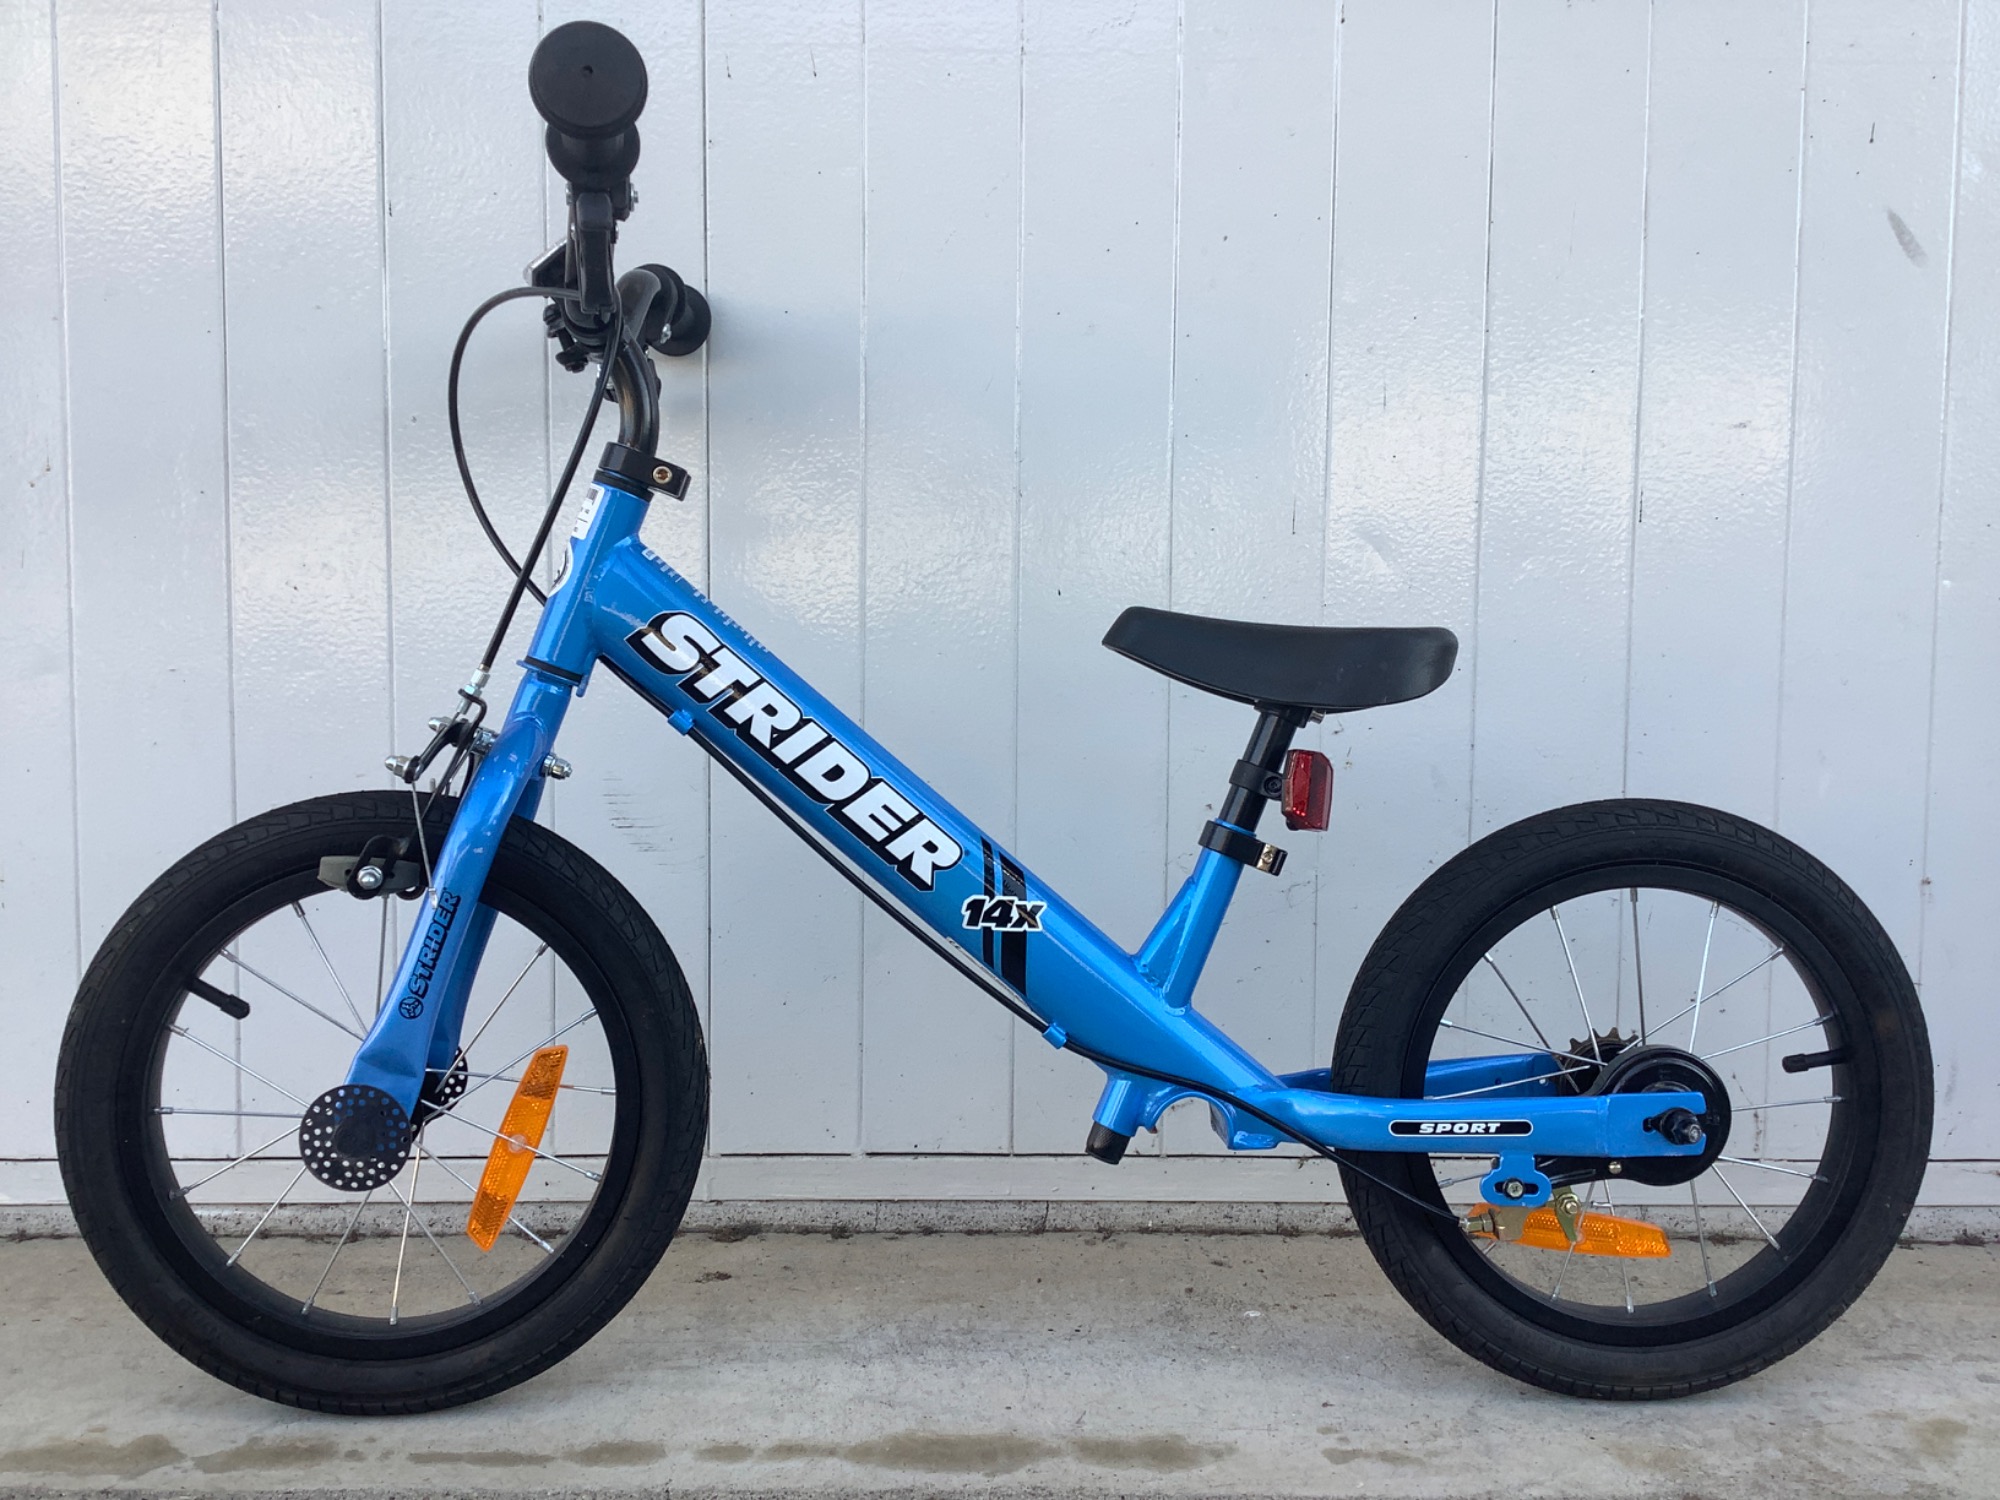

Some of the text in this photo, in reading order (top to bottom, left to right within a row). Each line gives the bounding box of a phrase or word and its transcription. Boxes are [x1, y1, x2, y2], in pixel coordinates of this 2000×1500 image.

[625, 612, 962, 892] STRIDER
[409, 890, 461, 999] STRIDER
[1418, 1122, 1501, 1134] SPORT
